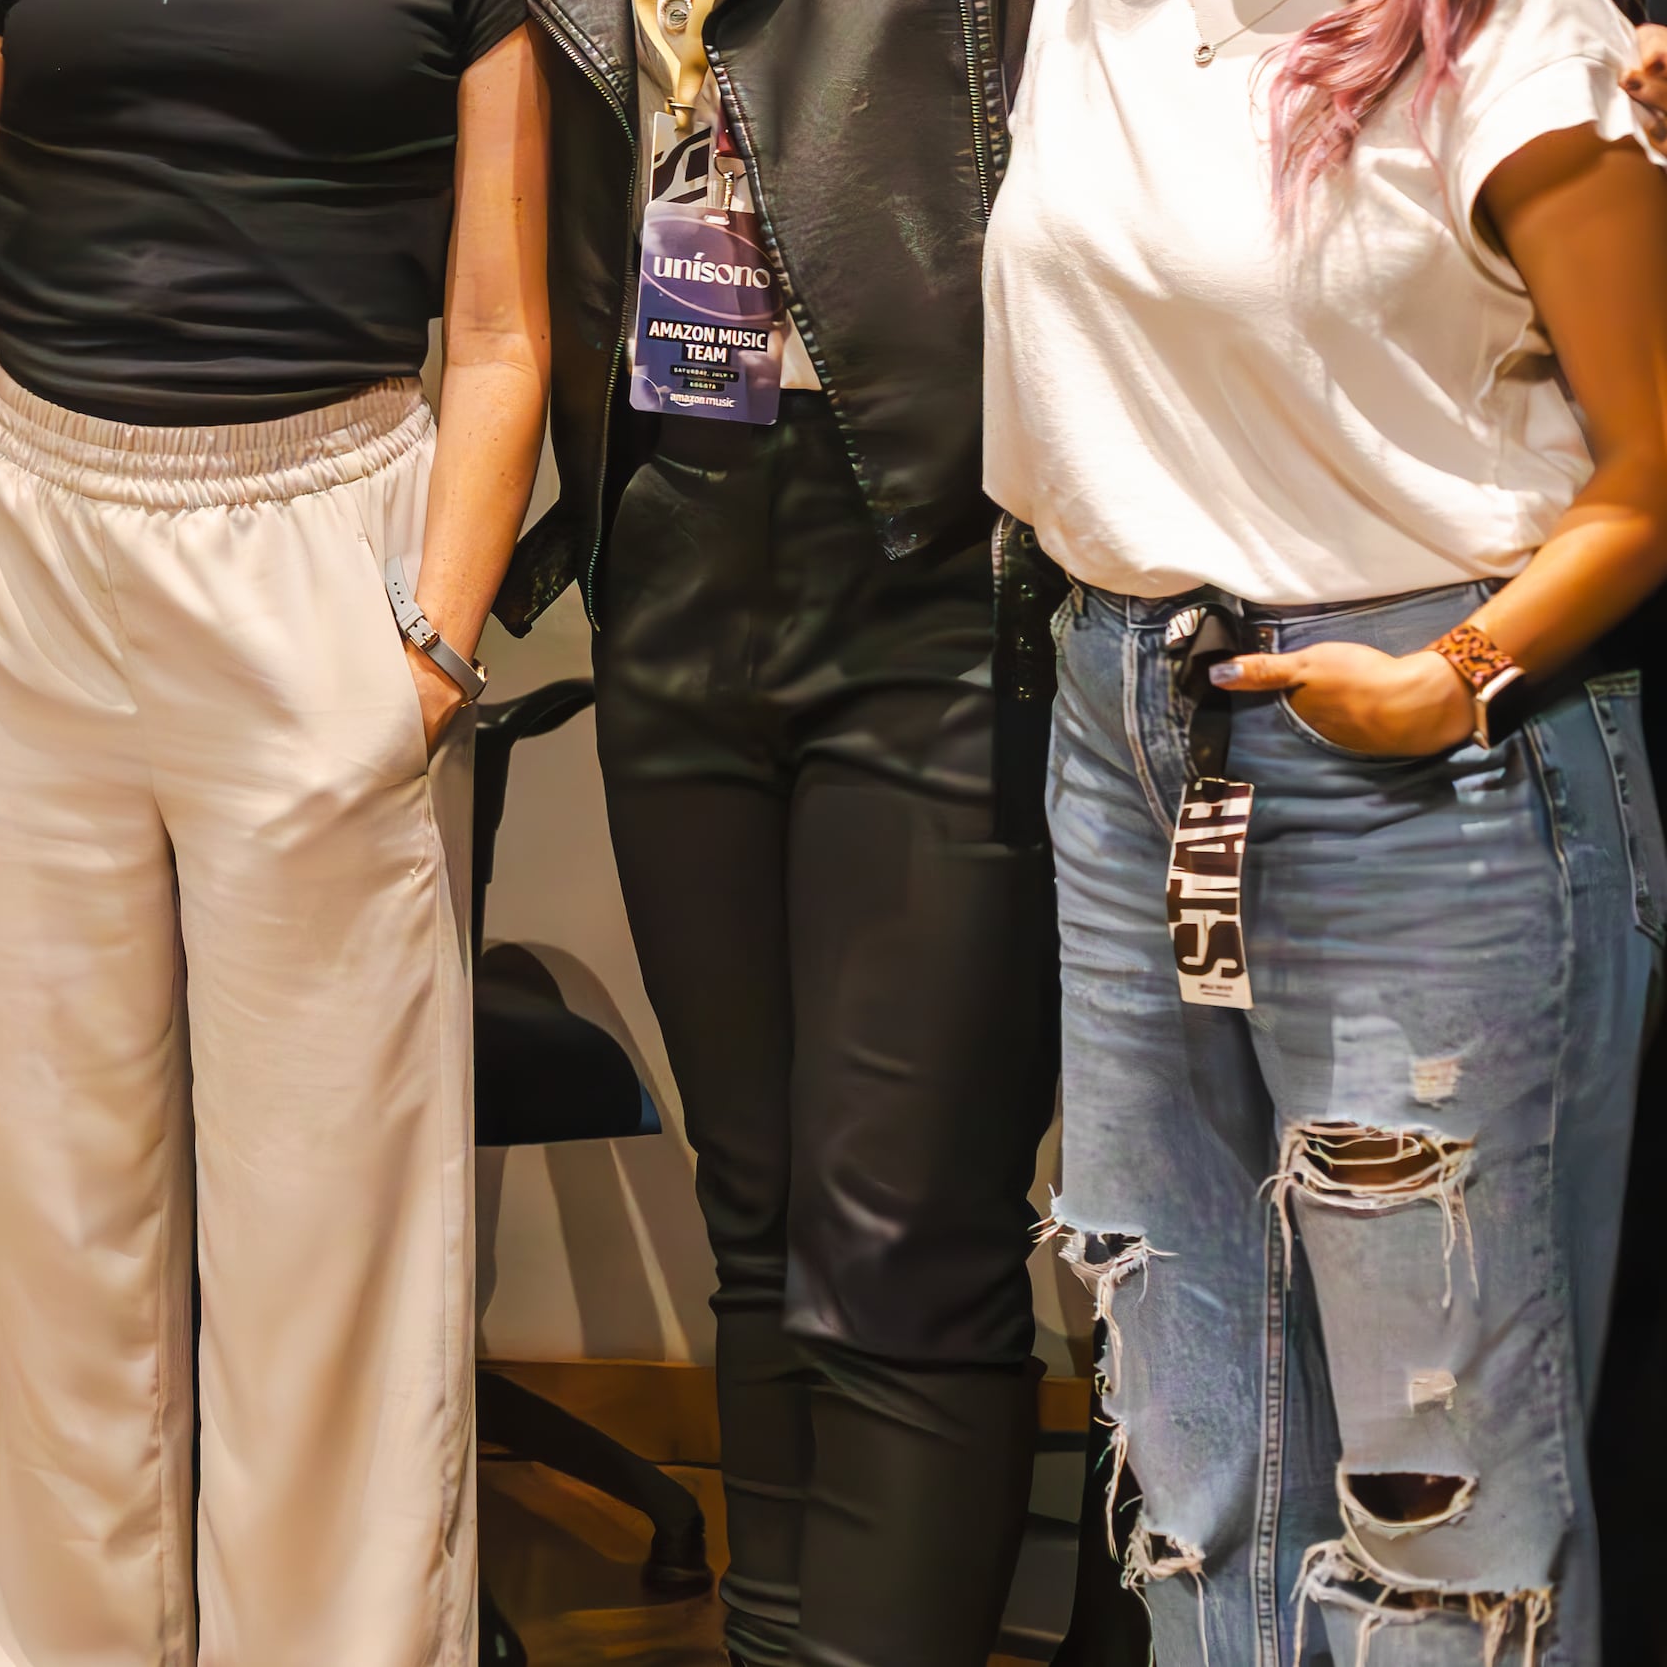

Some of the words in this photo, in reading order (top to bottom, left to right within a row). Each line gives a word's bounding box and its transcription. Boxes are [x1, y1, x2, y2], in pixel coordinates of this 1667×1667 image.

[653, 252, 771, 290] unísono
[648, 320, 715, 344] AMAZON
[718, 329, 767, 349] MUSIC
[685, 343, 728, 363] TEAM
[669, 393, 706, 405] amazon
[705, 397, 737, 408] music
